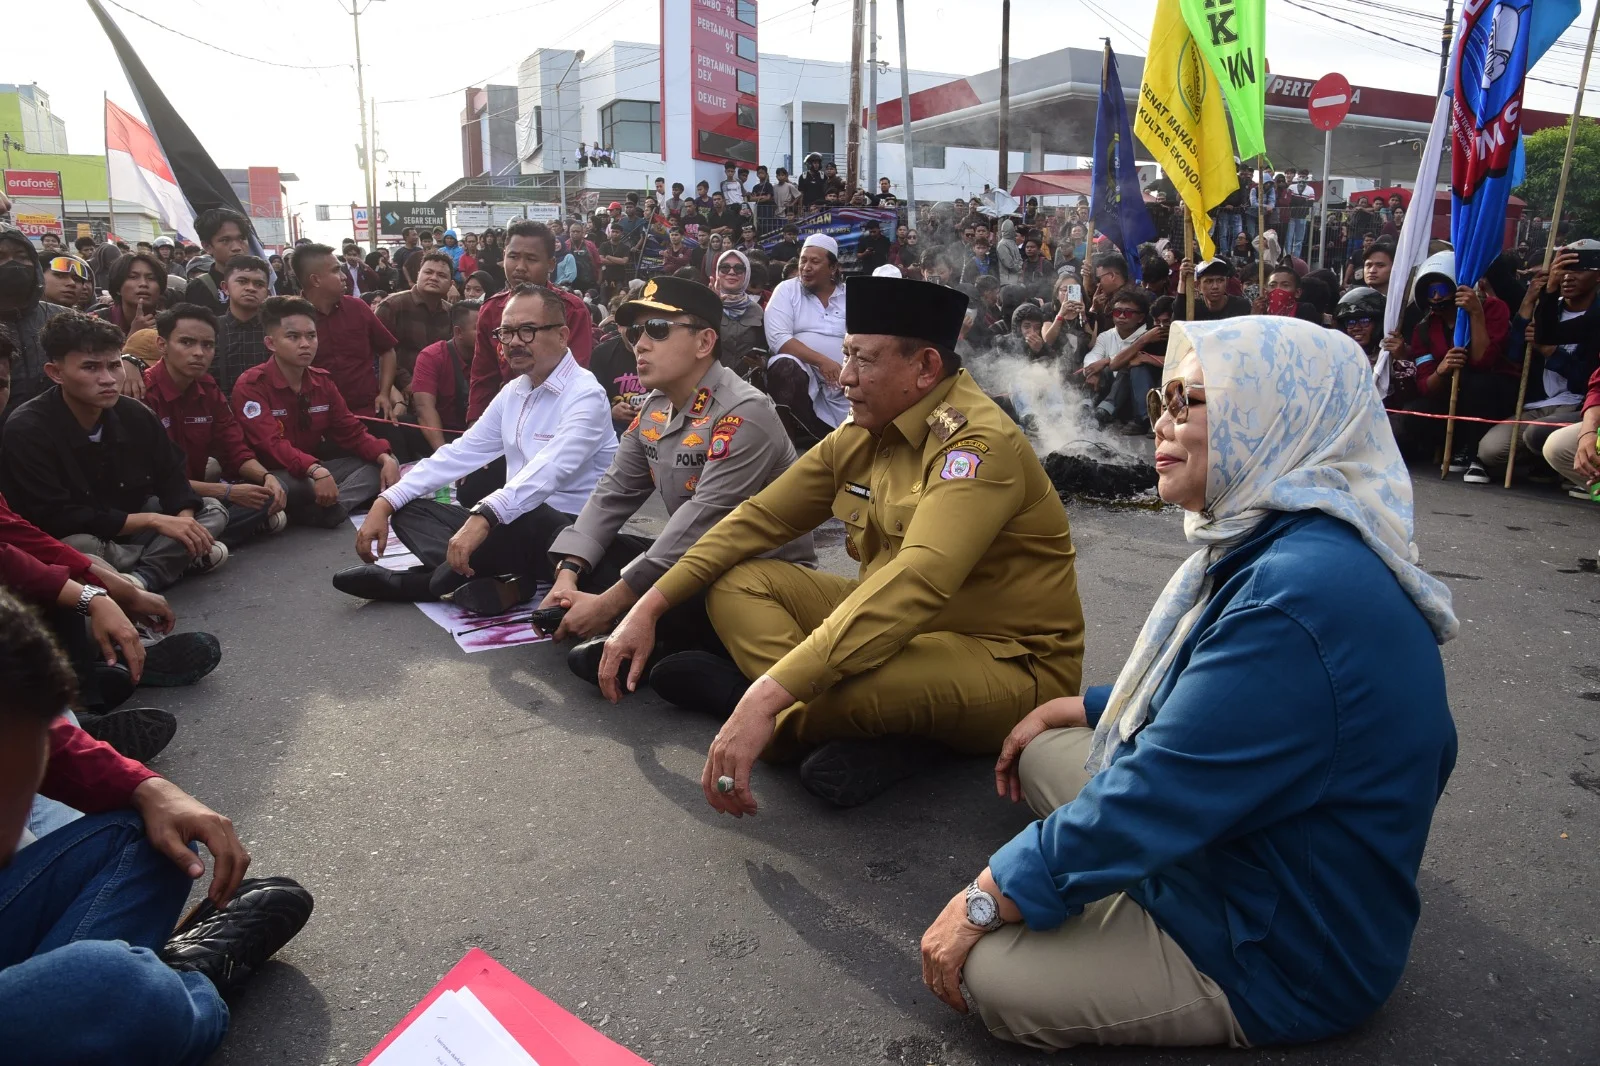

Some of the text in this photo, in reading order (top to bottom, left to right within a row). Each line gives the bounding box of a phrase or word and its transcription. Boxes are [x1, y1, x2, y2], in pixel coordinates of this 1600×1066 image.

[726, 6, 735, 18] 98
[697, 16, 735, 41] PERTAMAX
[725, 43, 735, 55] 92
[697, 53, 736, 77] PERTAMINA
[697, 67, 712, 82] DEX
[697, 90, 727, 109] DEXLITE
[1141, 82, 1169, 117] SENAT
[1138, 106, 1170, 148] KULTAS
[8, 178, 54, 188] erafone
[1140, 173, 1147, 183] 4
[411, 207, 435, 215] APOTEK
[403, 216, 444, 225] SEGAR SEHAT
